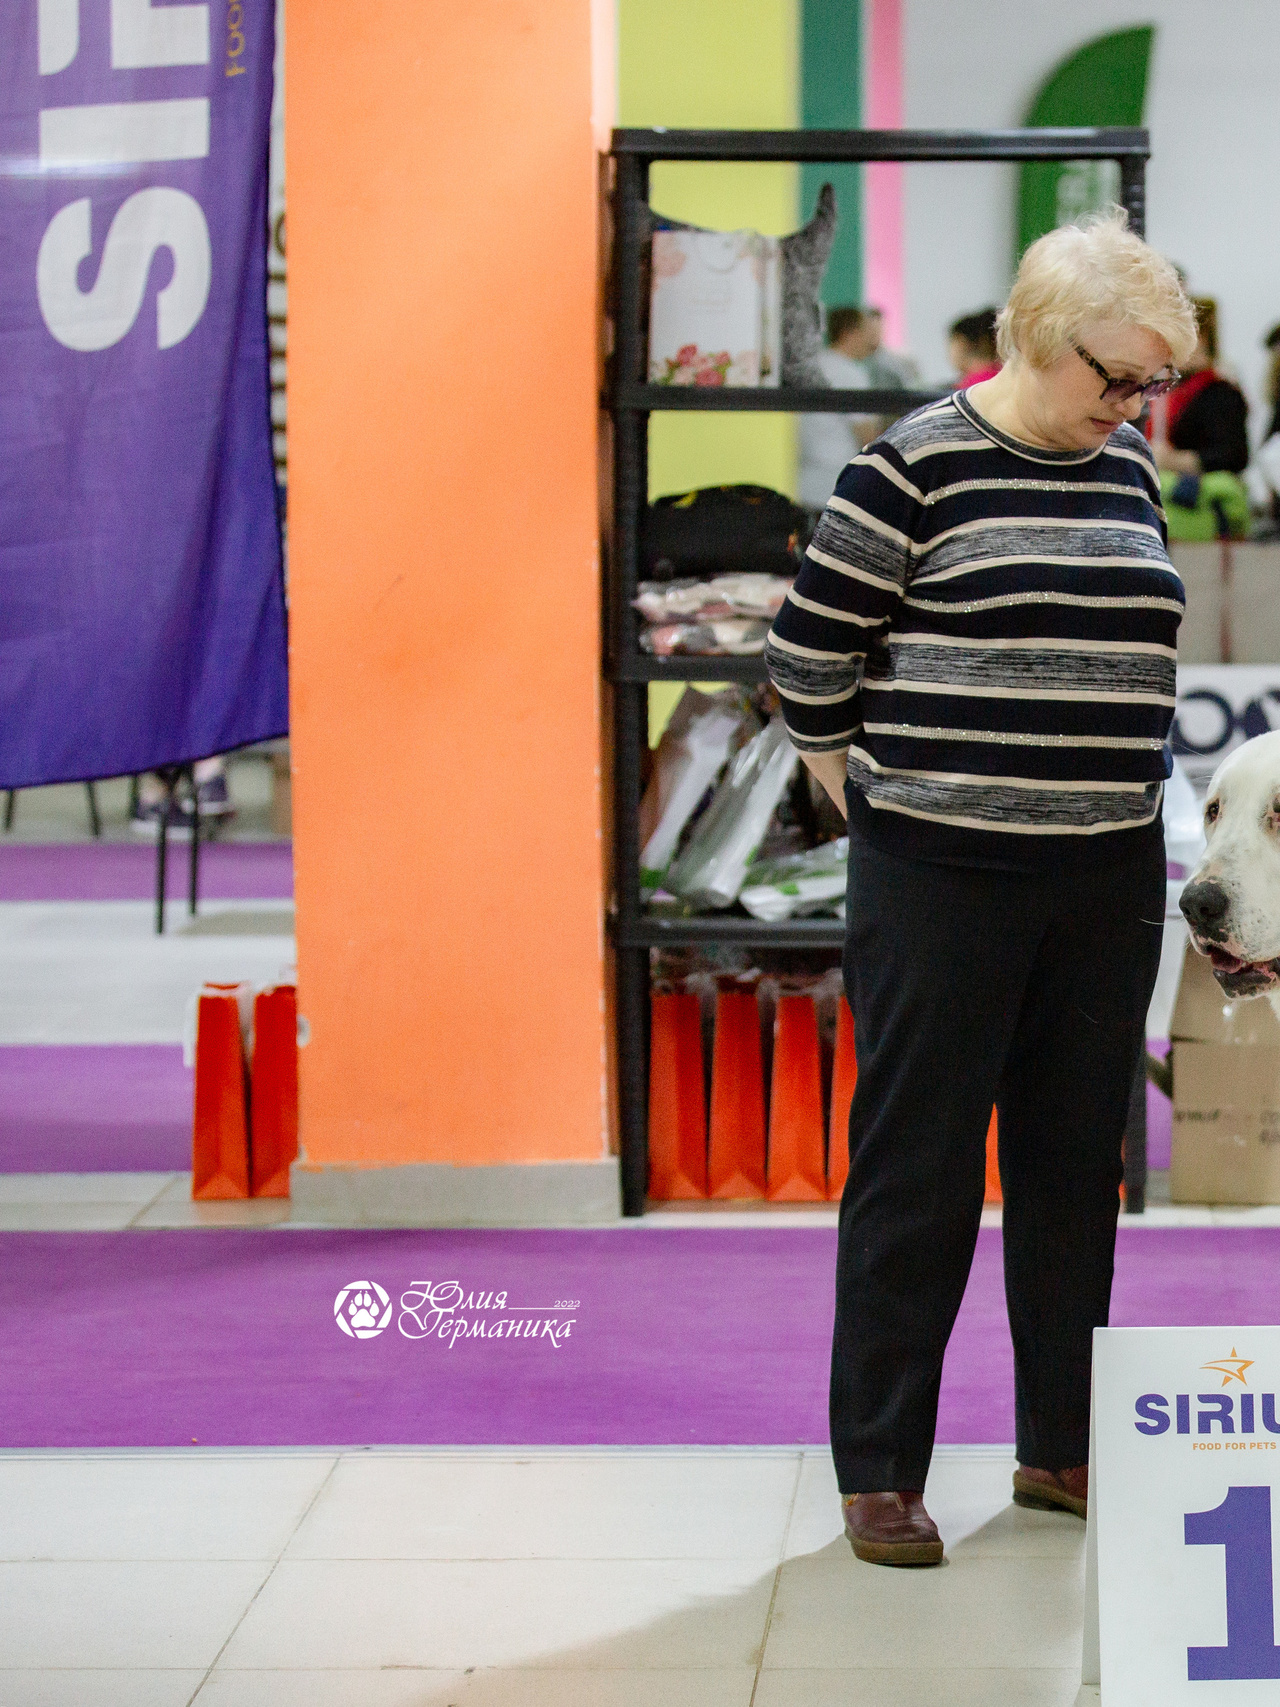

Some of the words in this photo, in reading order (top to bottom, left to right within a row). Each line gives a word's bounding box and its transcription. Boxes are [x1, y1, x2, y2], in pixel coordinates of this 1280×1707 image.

[225, 0, 247, 77] FOO
[1192, 1441, 1222, 1451] FOOD
[1225, 1441, 1247, 1451] FOR
[1249, 1441, 1277, 1451] PETS
